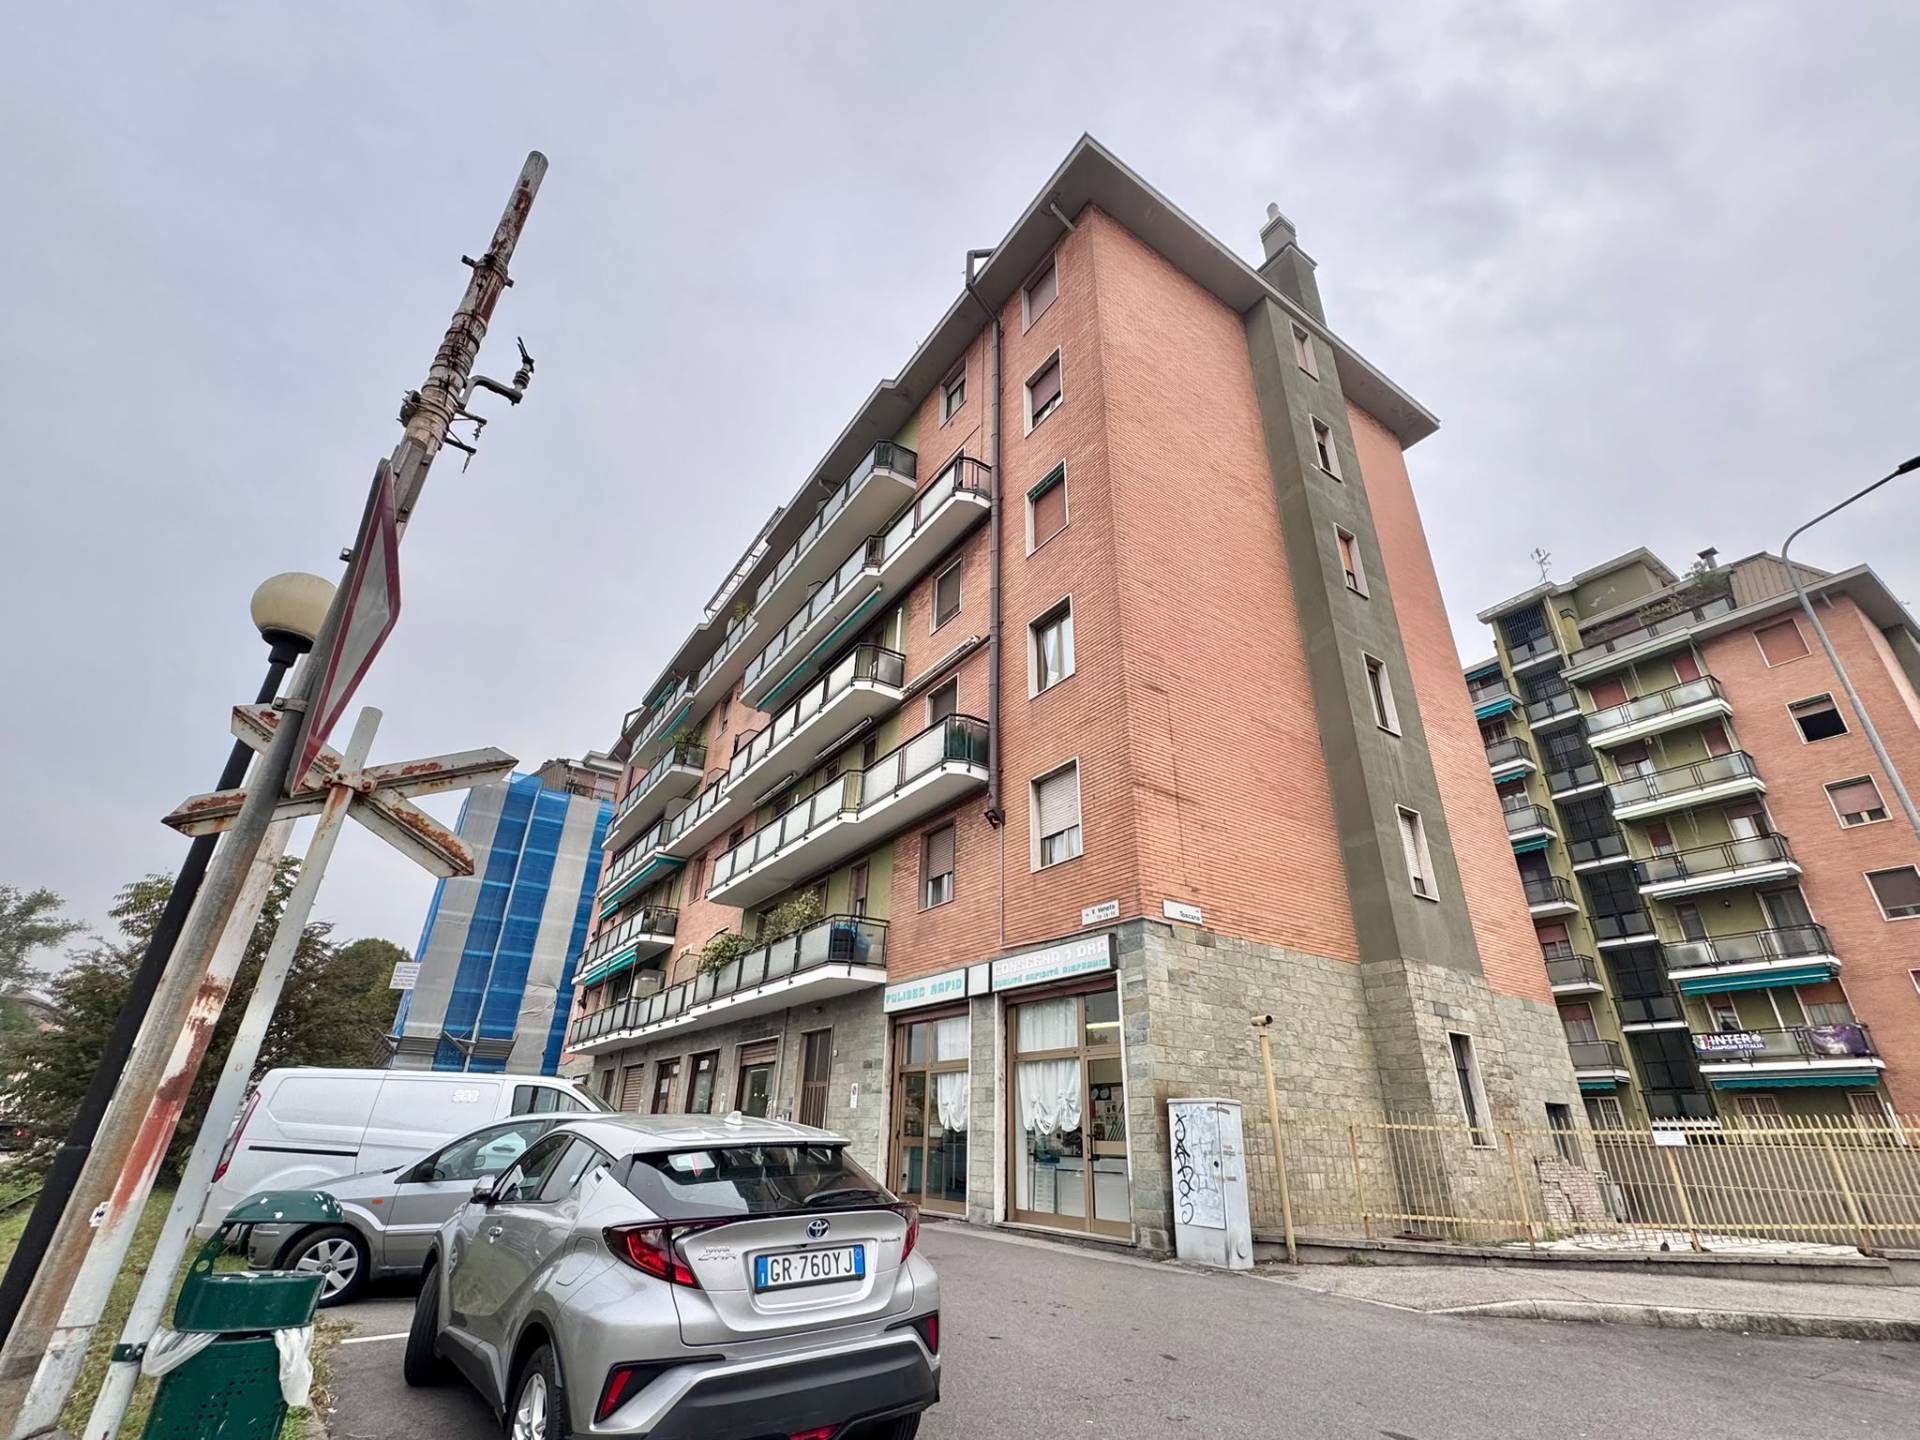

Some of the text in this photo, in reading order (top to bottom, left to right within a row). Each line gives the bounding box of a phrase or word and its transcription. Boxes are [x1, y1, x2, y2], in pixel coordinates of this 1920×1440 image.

[1179, 910, 1200, 921] Toscana
[1077, 939, 1107, 958] ORA
[1710, 1034, 1752, 1045] INTER
[770, 1250, 853, 1282] GR 760YJ
